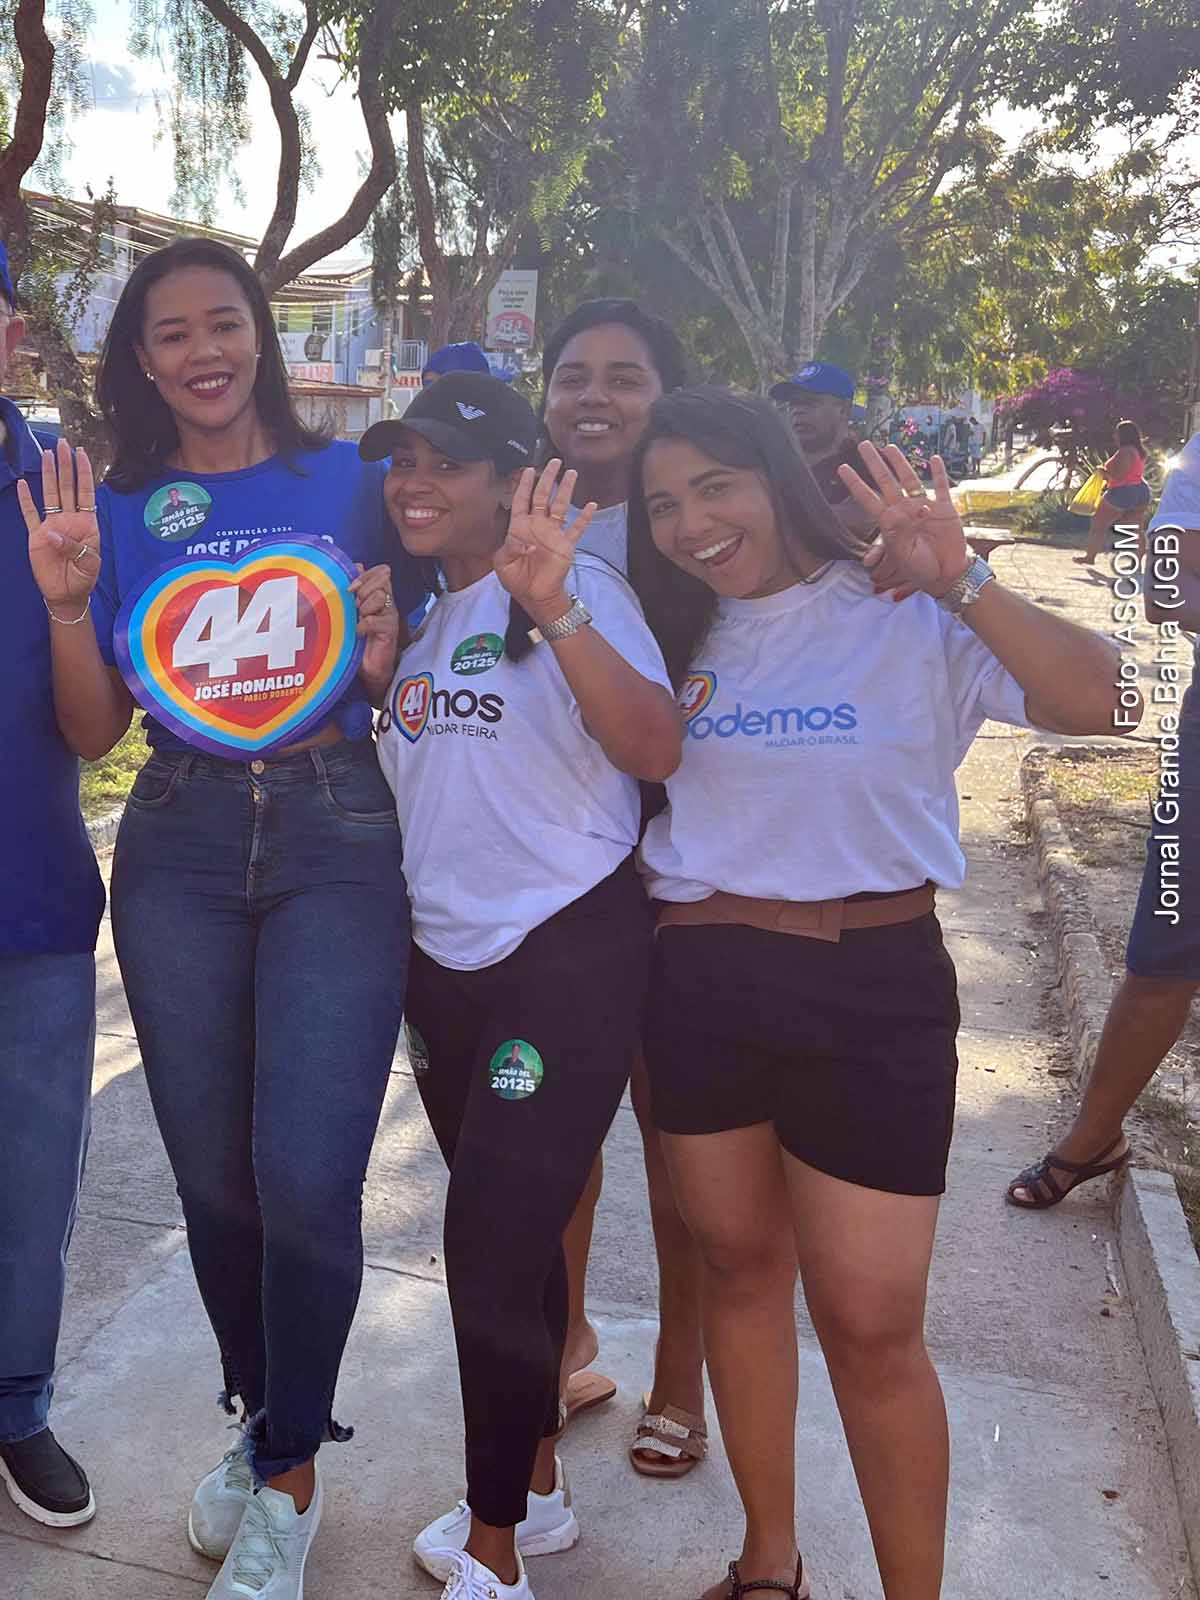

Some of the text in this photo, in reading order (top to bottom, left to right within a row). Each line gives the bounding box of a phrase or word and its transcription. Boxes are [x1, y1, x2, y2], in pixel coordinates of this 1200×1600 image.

[159, 512, 206, 537] 20125
[216, 528, 268, 537] CONVENÇÃO
[172, 576, 305, 679] 44
[453, 657, 497, 672] 20125
[194, 672, 305, 701] JOSÉ RONALDO
[687, 702, 858, 740] odemos
[461, 723, 498, 741] FEIRA
[818, 735, 860, 745] BRASIL
[491, 1076, 536, 1092] 20125
